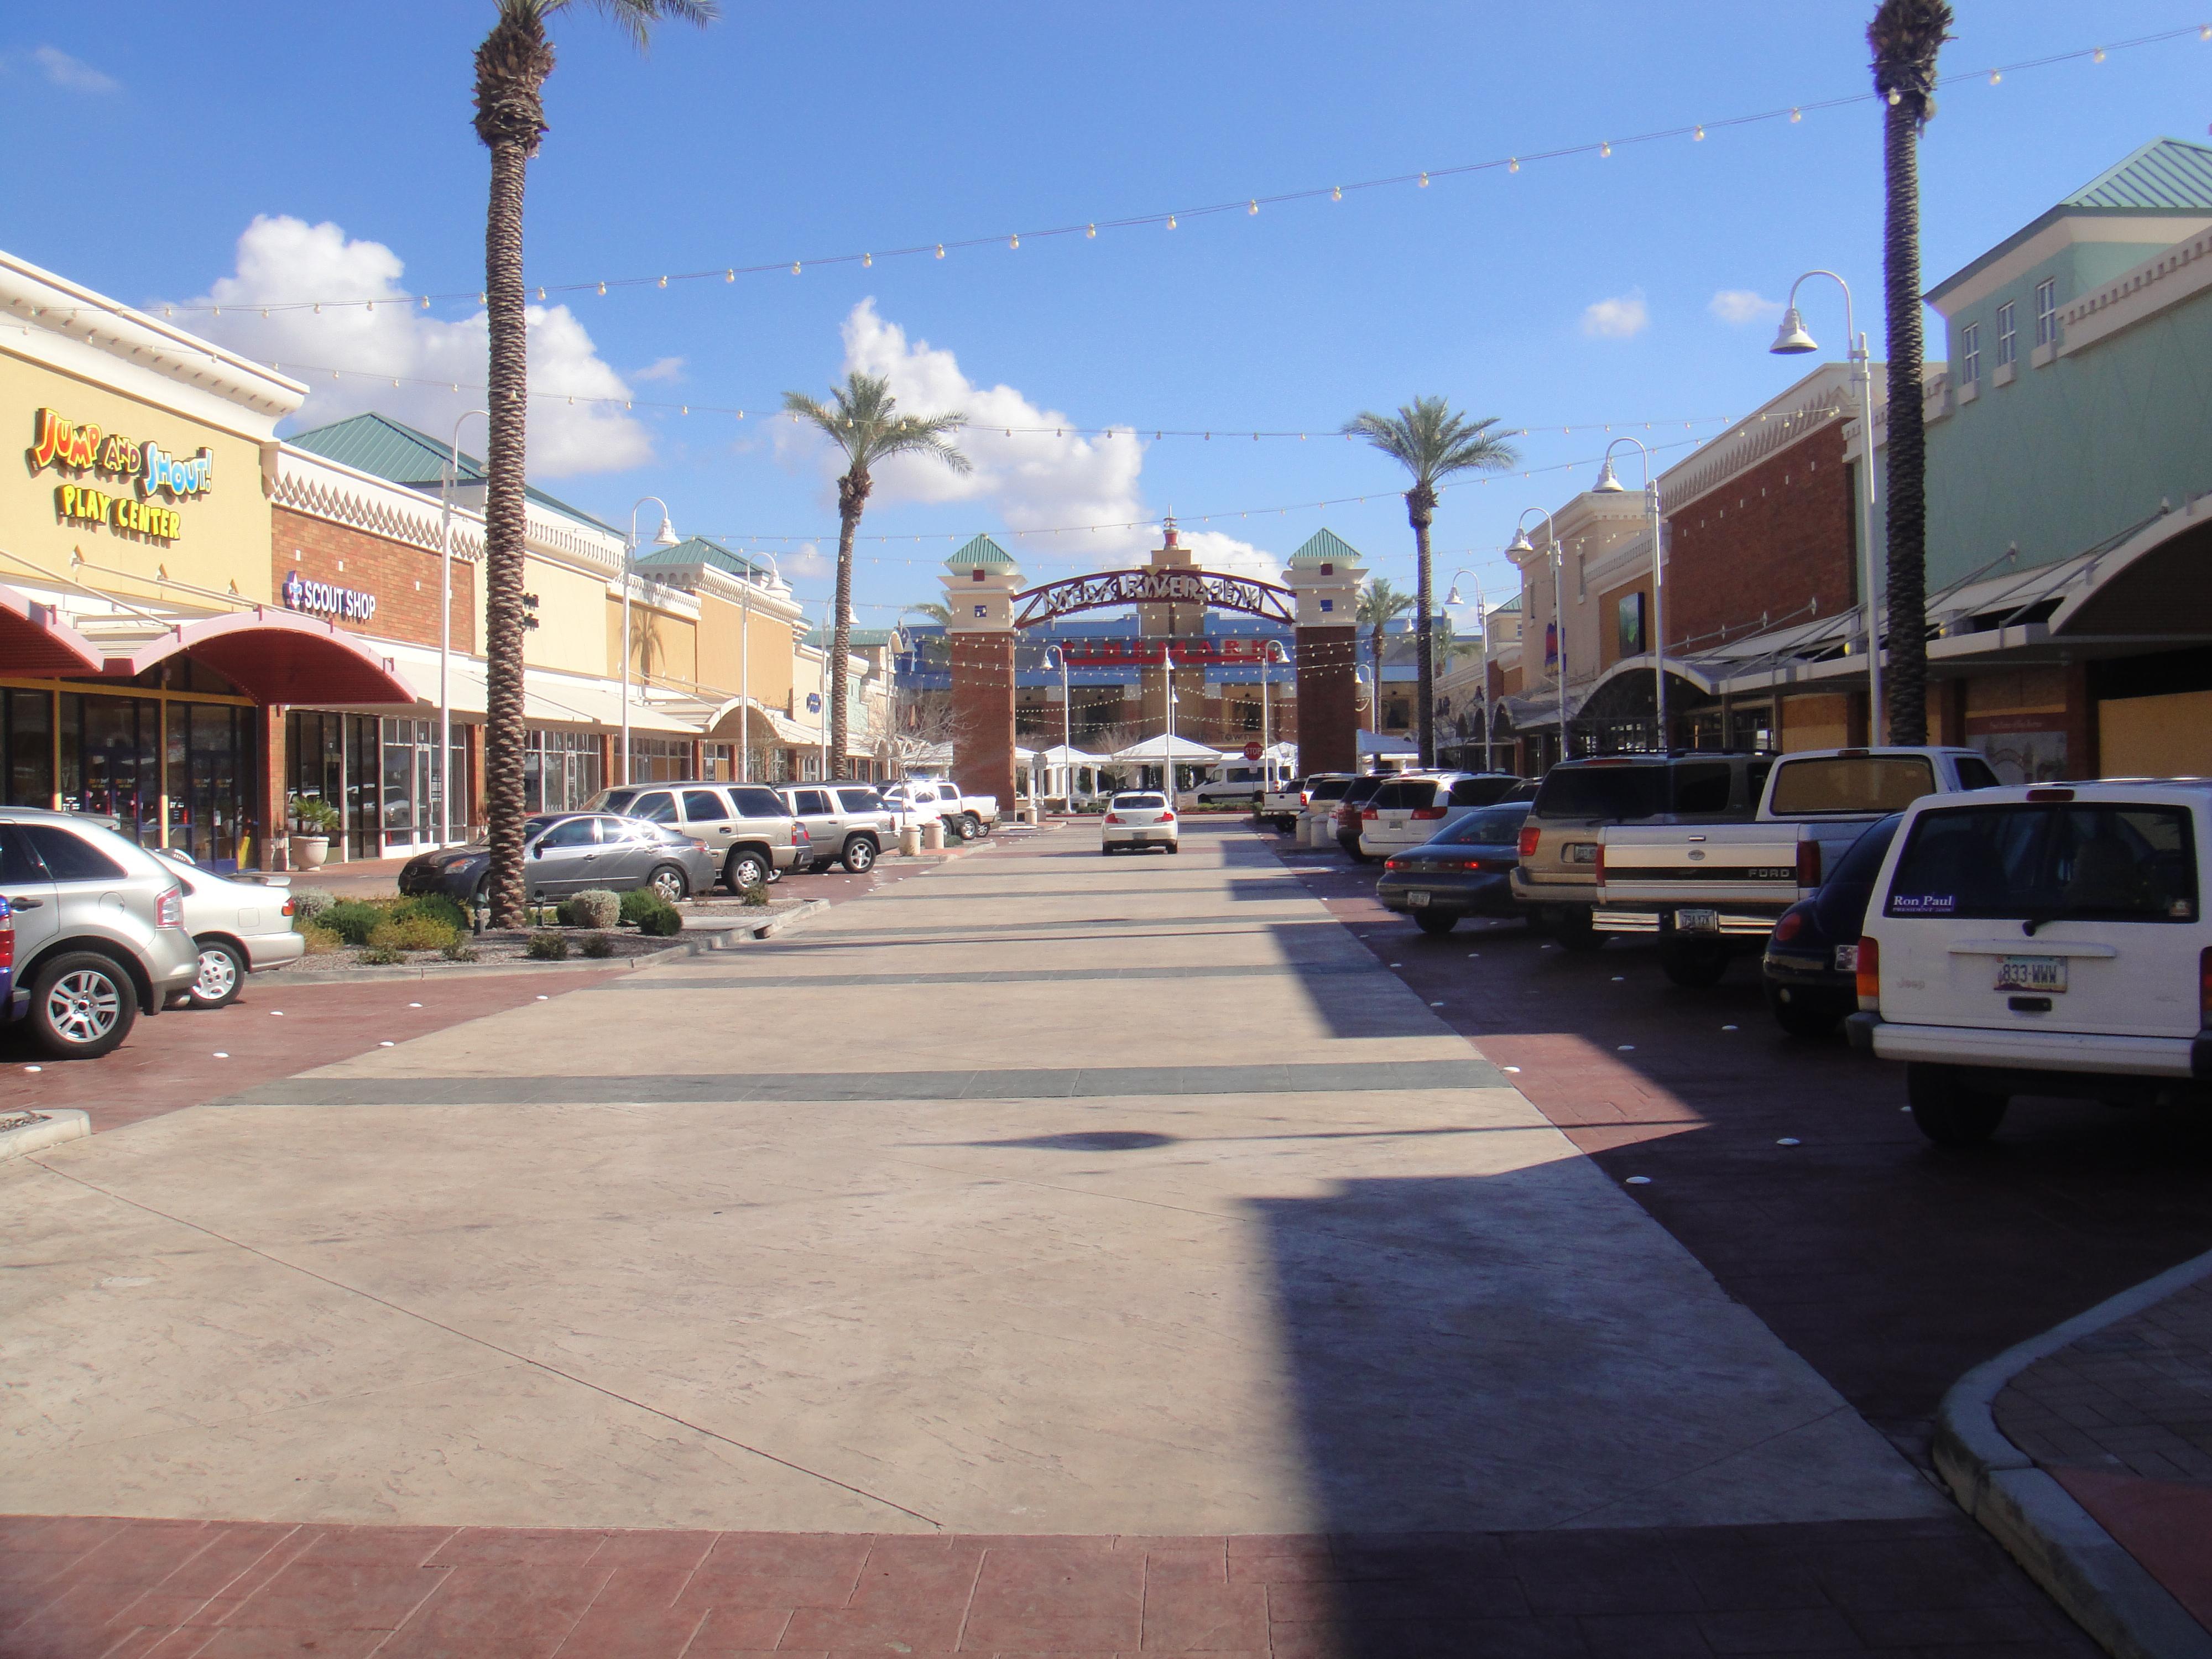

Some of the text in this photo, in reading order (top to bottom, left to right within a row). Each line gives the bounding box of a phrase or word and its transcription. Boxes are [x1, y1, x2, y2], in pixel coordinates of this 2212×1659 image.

[32, 408, 214, 497] JUMP AND SHOUT!
[57, 484, 181, 540] PLAY CENTER
[305, 580, 375, 620] SCOUT SHOP
[1040, 581, 1118, 614] MESA
[1245, 747, 1262, 755] STOP
[1748, 869, 1790, 878] FORD
[1893, 895, 1952, 906] Ron Paul
